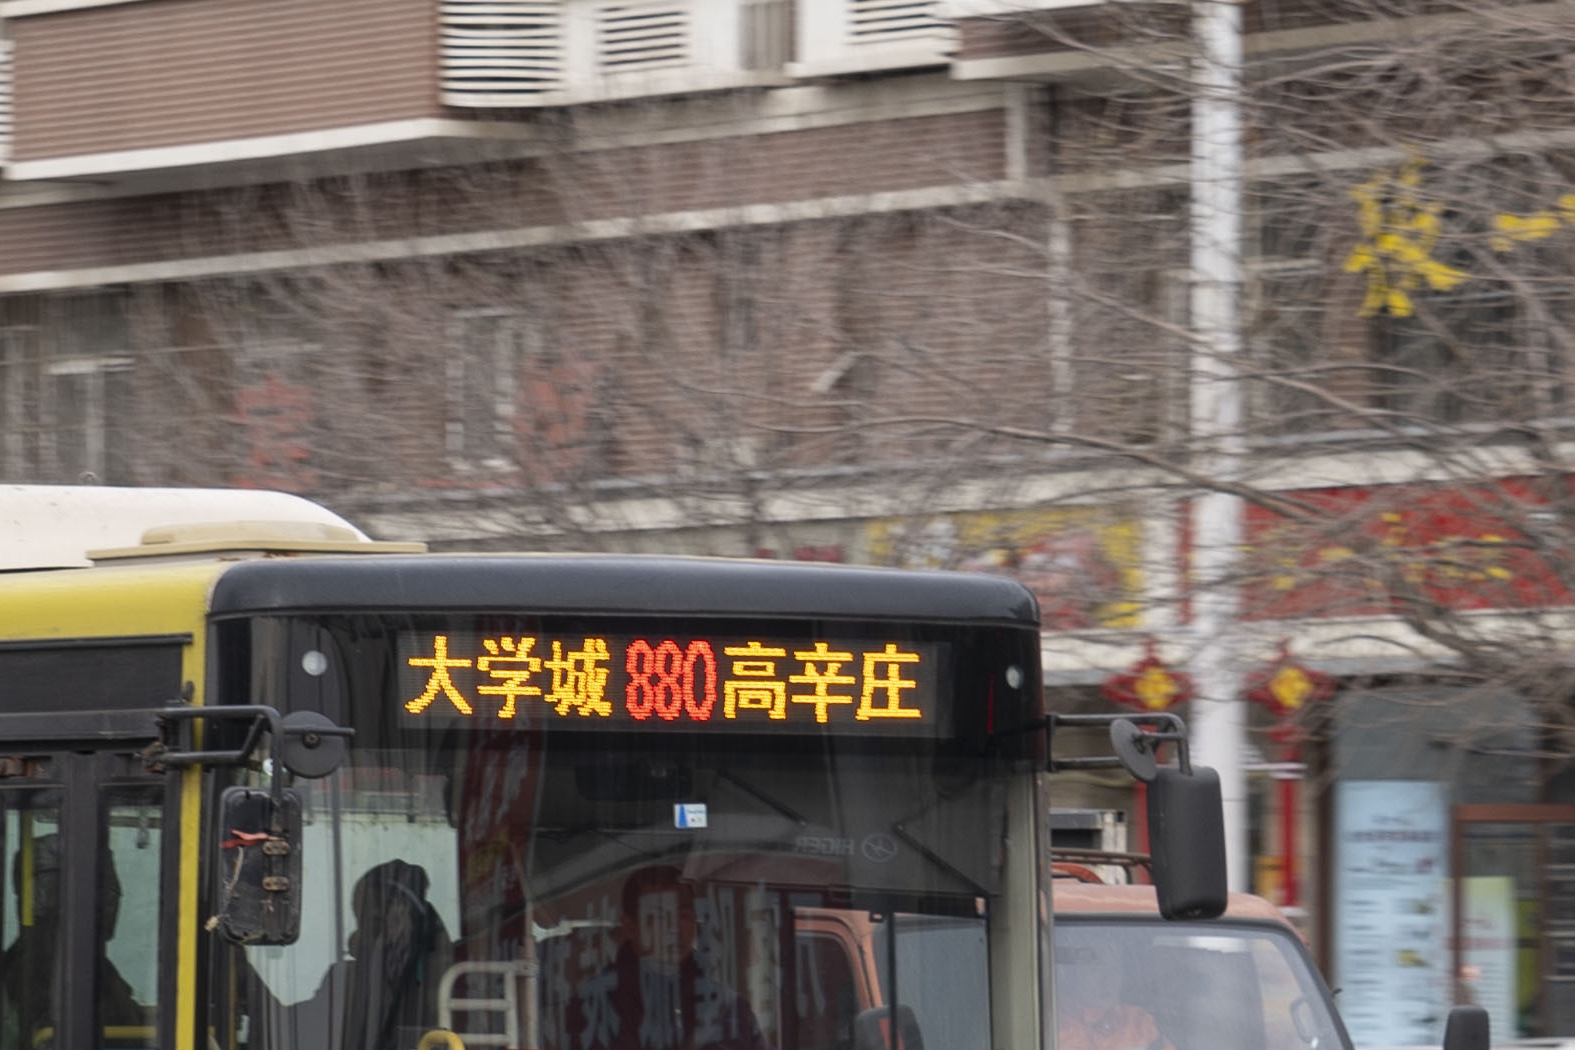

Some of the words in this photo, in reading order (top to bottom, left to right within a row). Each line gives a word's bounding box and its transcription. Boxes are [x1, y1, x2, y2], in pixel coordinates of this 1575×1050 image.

[404, 635, 612, 718] 大学城
[625, 639, 718, 721] 880
[723, 640, 922, 722] 高辛庄
